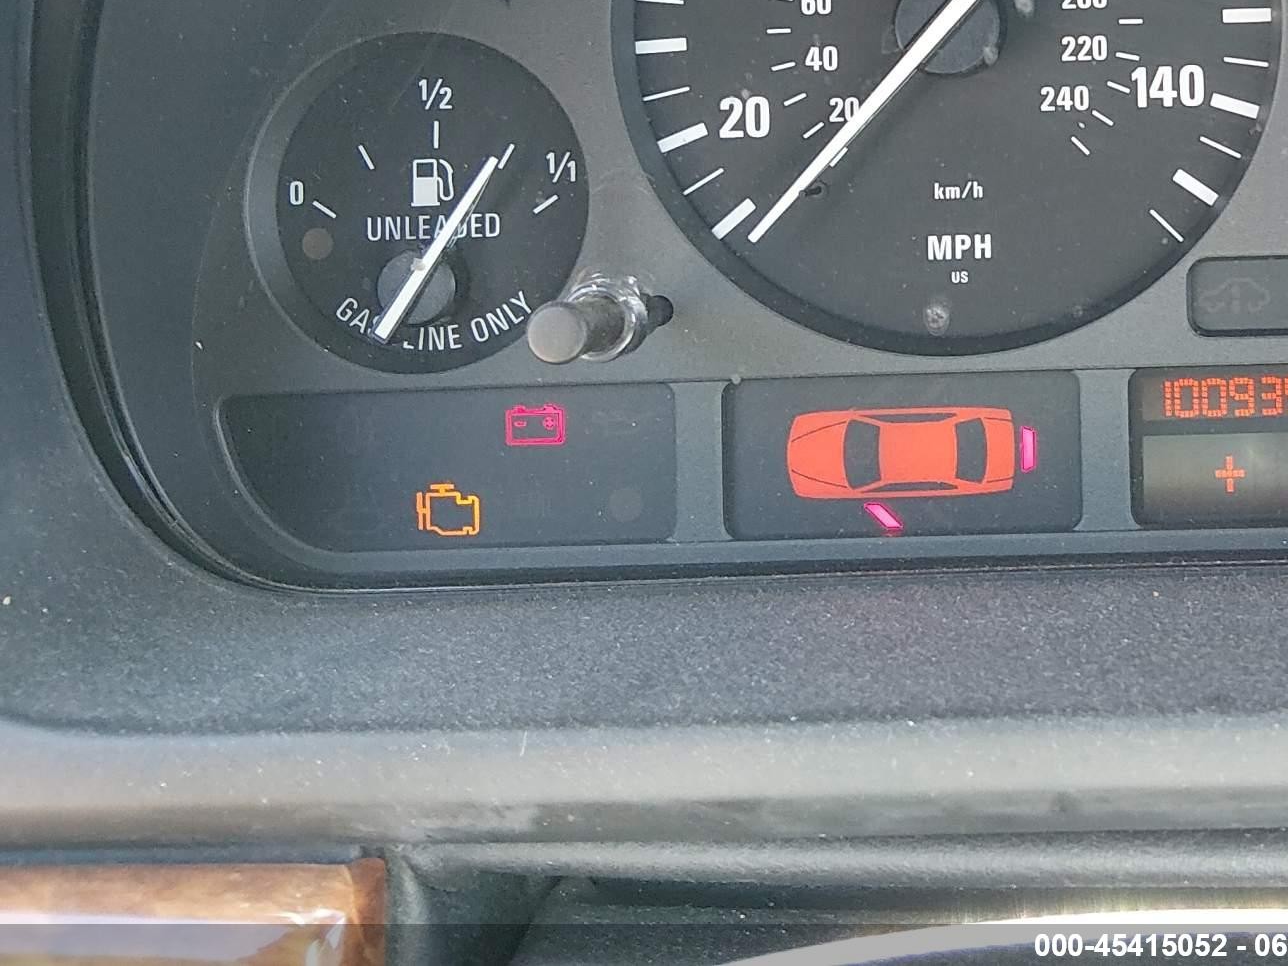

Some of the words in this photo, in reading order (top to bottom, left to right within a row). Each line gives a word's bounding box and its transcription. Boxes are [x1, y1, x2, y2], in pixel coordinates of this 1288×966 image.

[805, 46, 838, 71] 40
[1061, 36, 1107, 61] 220
[1131, 64, 1204, 108] 140
[829, 97, 860, 123] 20
[1040, 88, 1089, 111] 240
[719, 96, 770, 138] 20
[290, 181, 304, 205] 0
[933, 182, 983, 200] km/h
[927, 235, 991, 260] MPH
[951, 271, 968, 283] US
[335, 297, 463, 351] GAINE
[470, 290, 532, 343] ONLY
